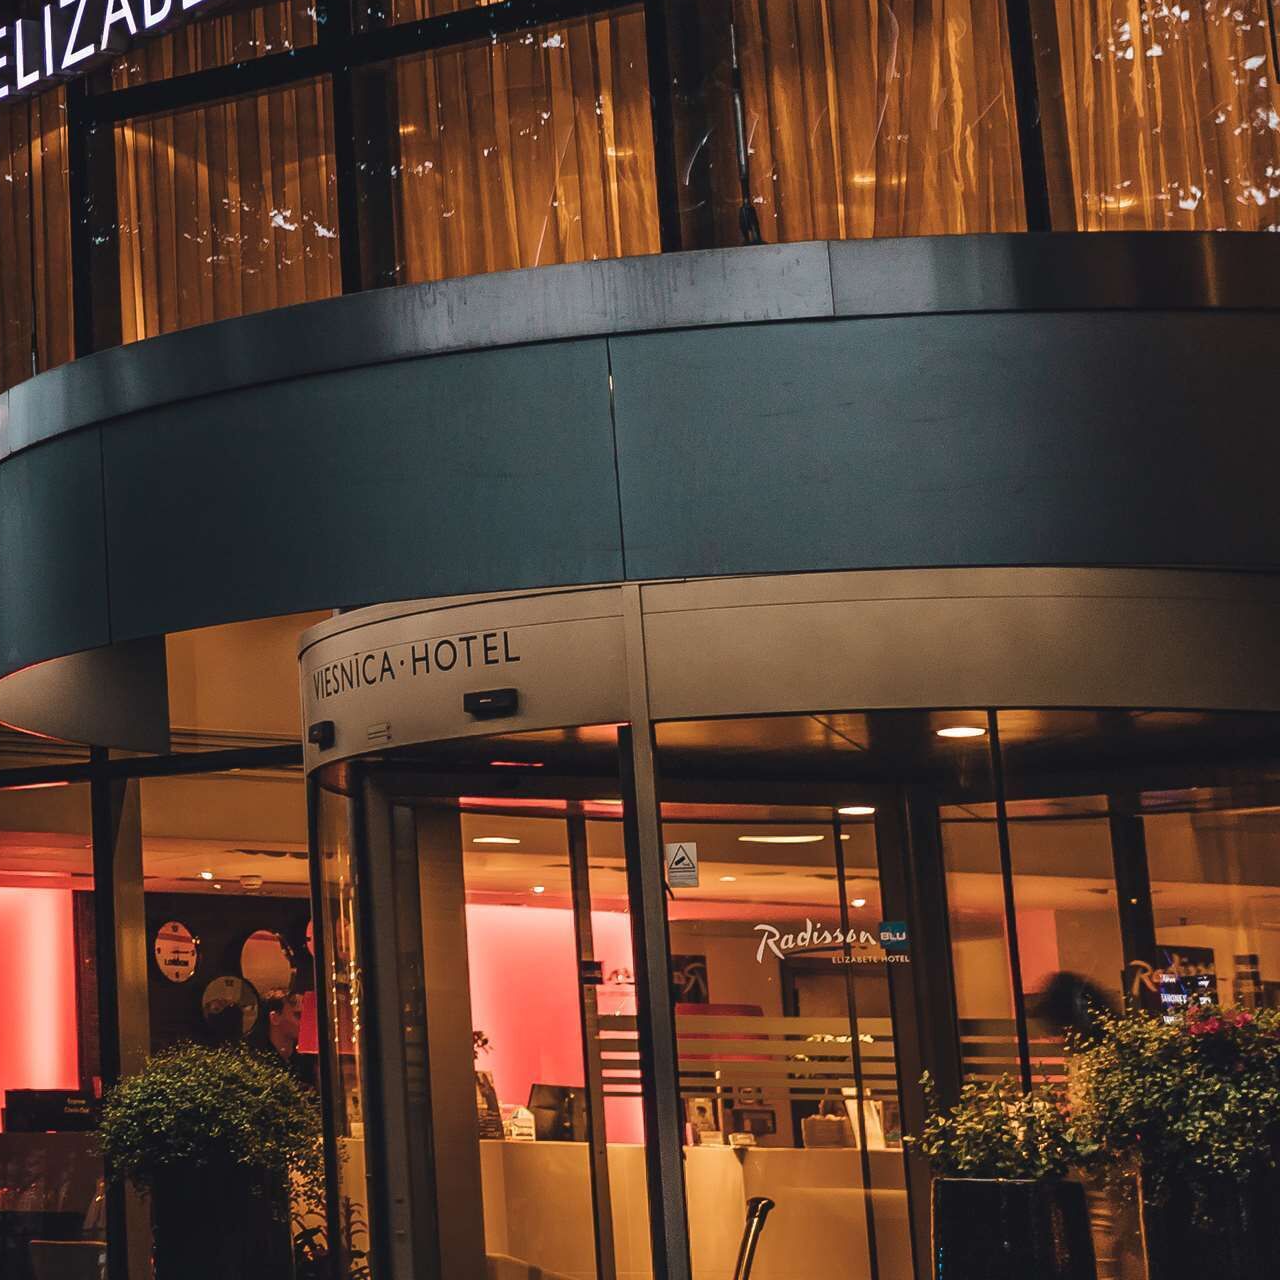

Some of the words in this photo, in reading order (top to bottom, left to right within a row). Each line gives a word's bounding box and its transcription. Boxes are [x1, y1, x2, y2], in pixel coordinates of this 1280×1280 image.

[411, 631, 521, 676] HOTEL
[753, 918, 877, 964] Radisson
[880, 931, 906, 941] BLU
[831, 955, 879, 965] ELIZABETE
[881, 954, 911, 964] HOTEL
